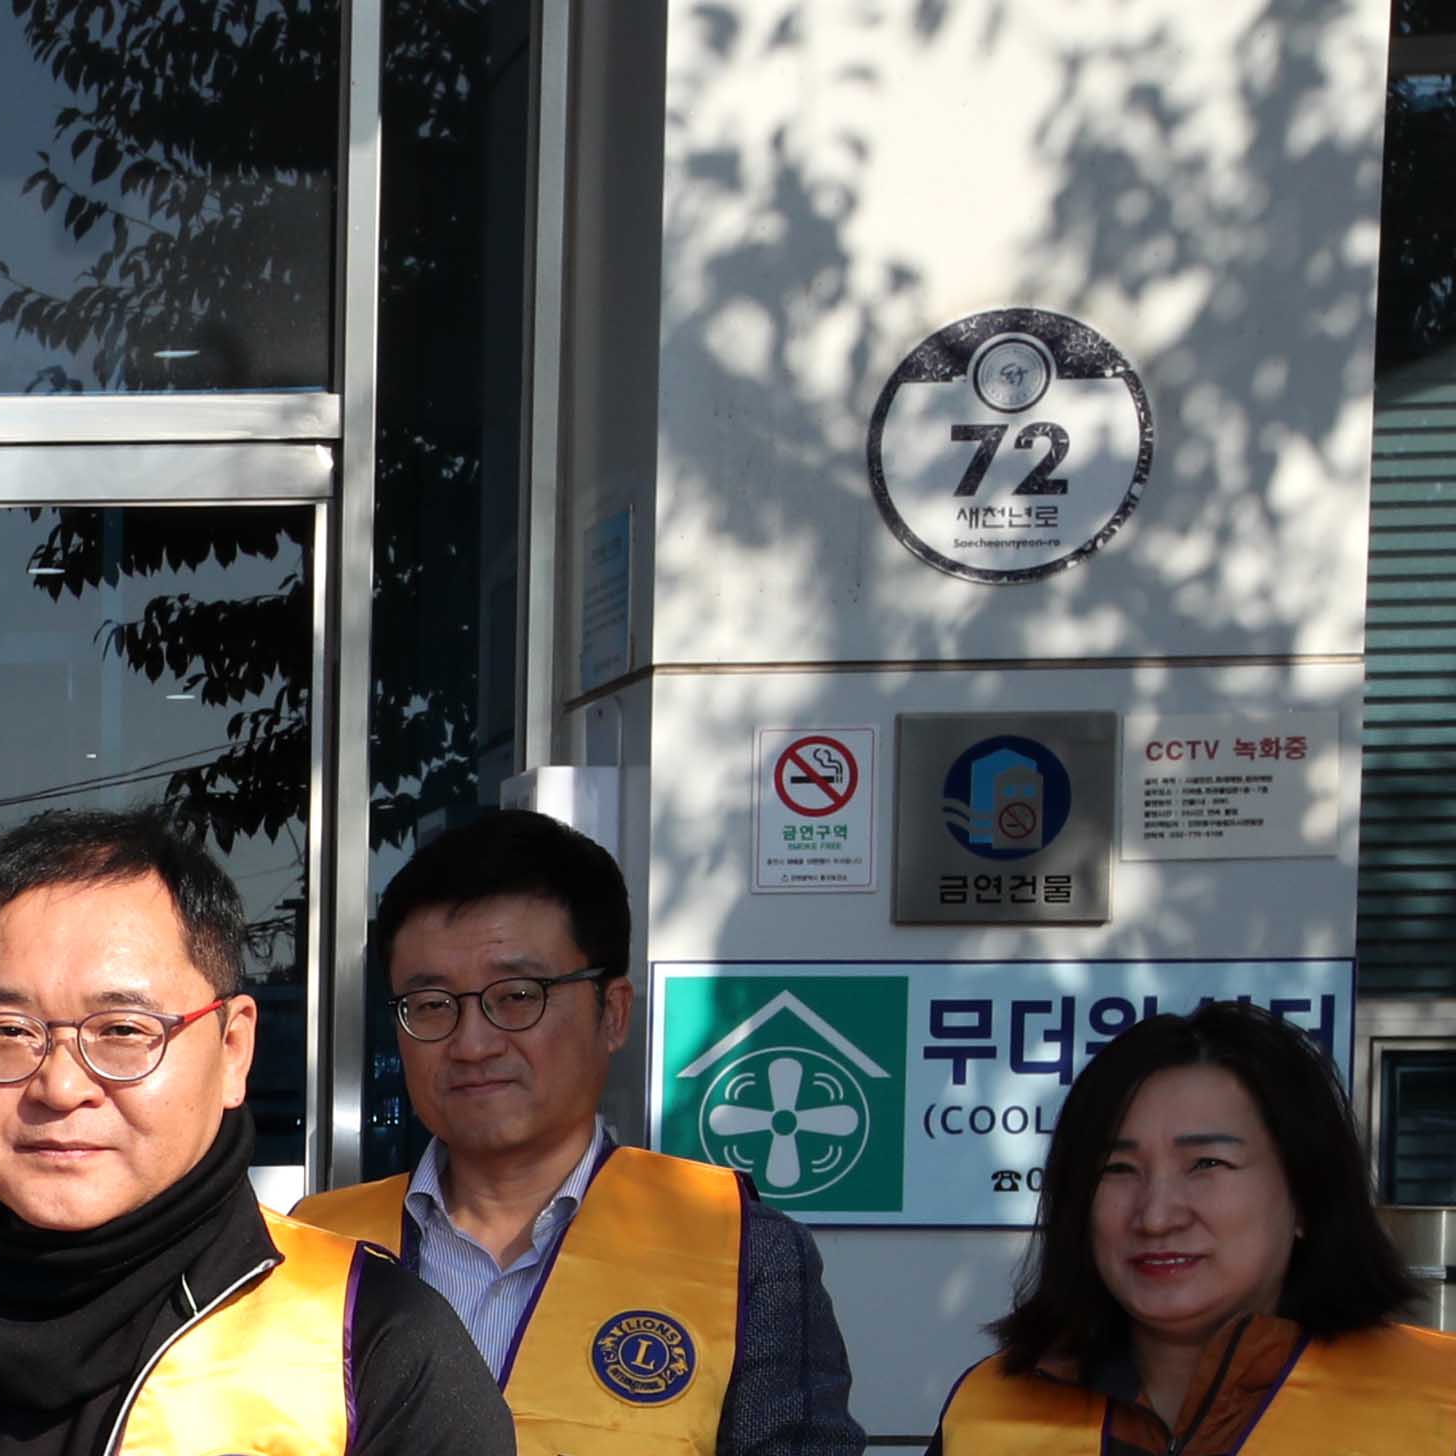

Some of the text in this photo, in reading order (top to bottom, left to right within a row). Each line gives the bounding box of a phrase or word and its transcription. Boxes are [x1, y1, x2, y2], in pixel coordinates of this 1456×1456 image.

[950, 421, 1071, 498] 72
[955, 505, 1059, 530] 새천년로
[1144, 735, 1309, 762] CCTV 녹화중
[782, 823, 849, 842] 금연구역
[937, 872, 1073, 905] 금연건물
[922, 992, 1336, 1086] 무더위
[922, 1102, 1055, 1139] (COOL
[626, 1318, 679, 1345] LIONS
[630, 1338, 656, 1371] L
